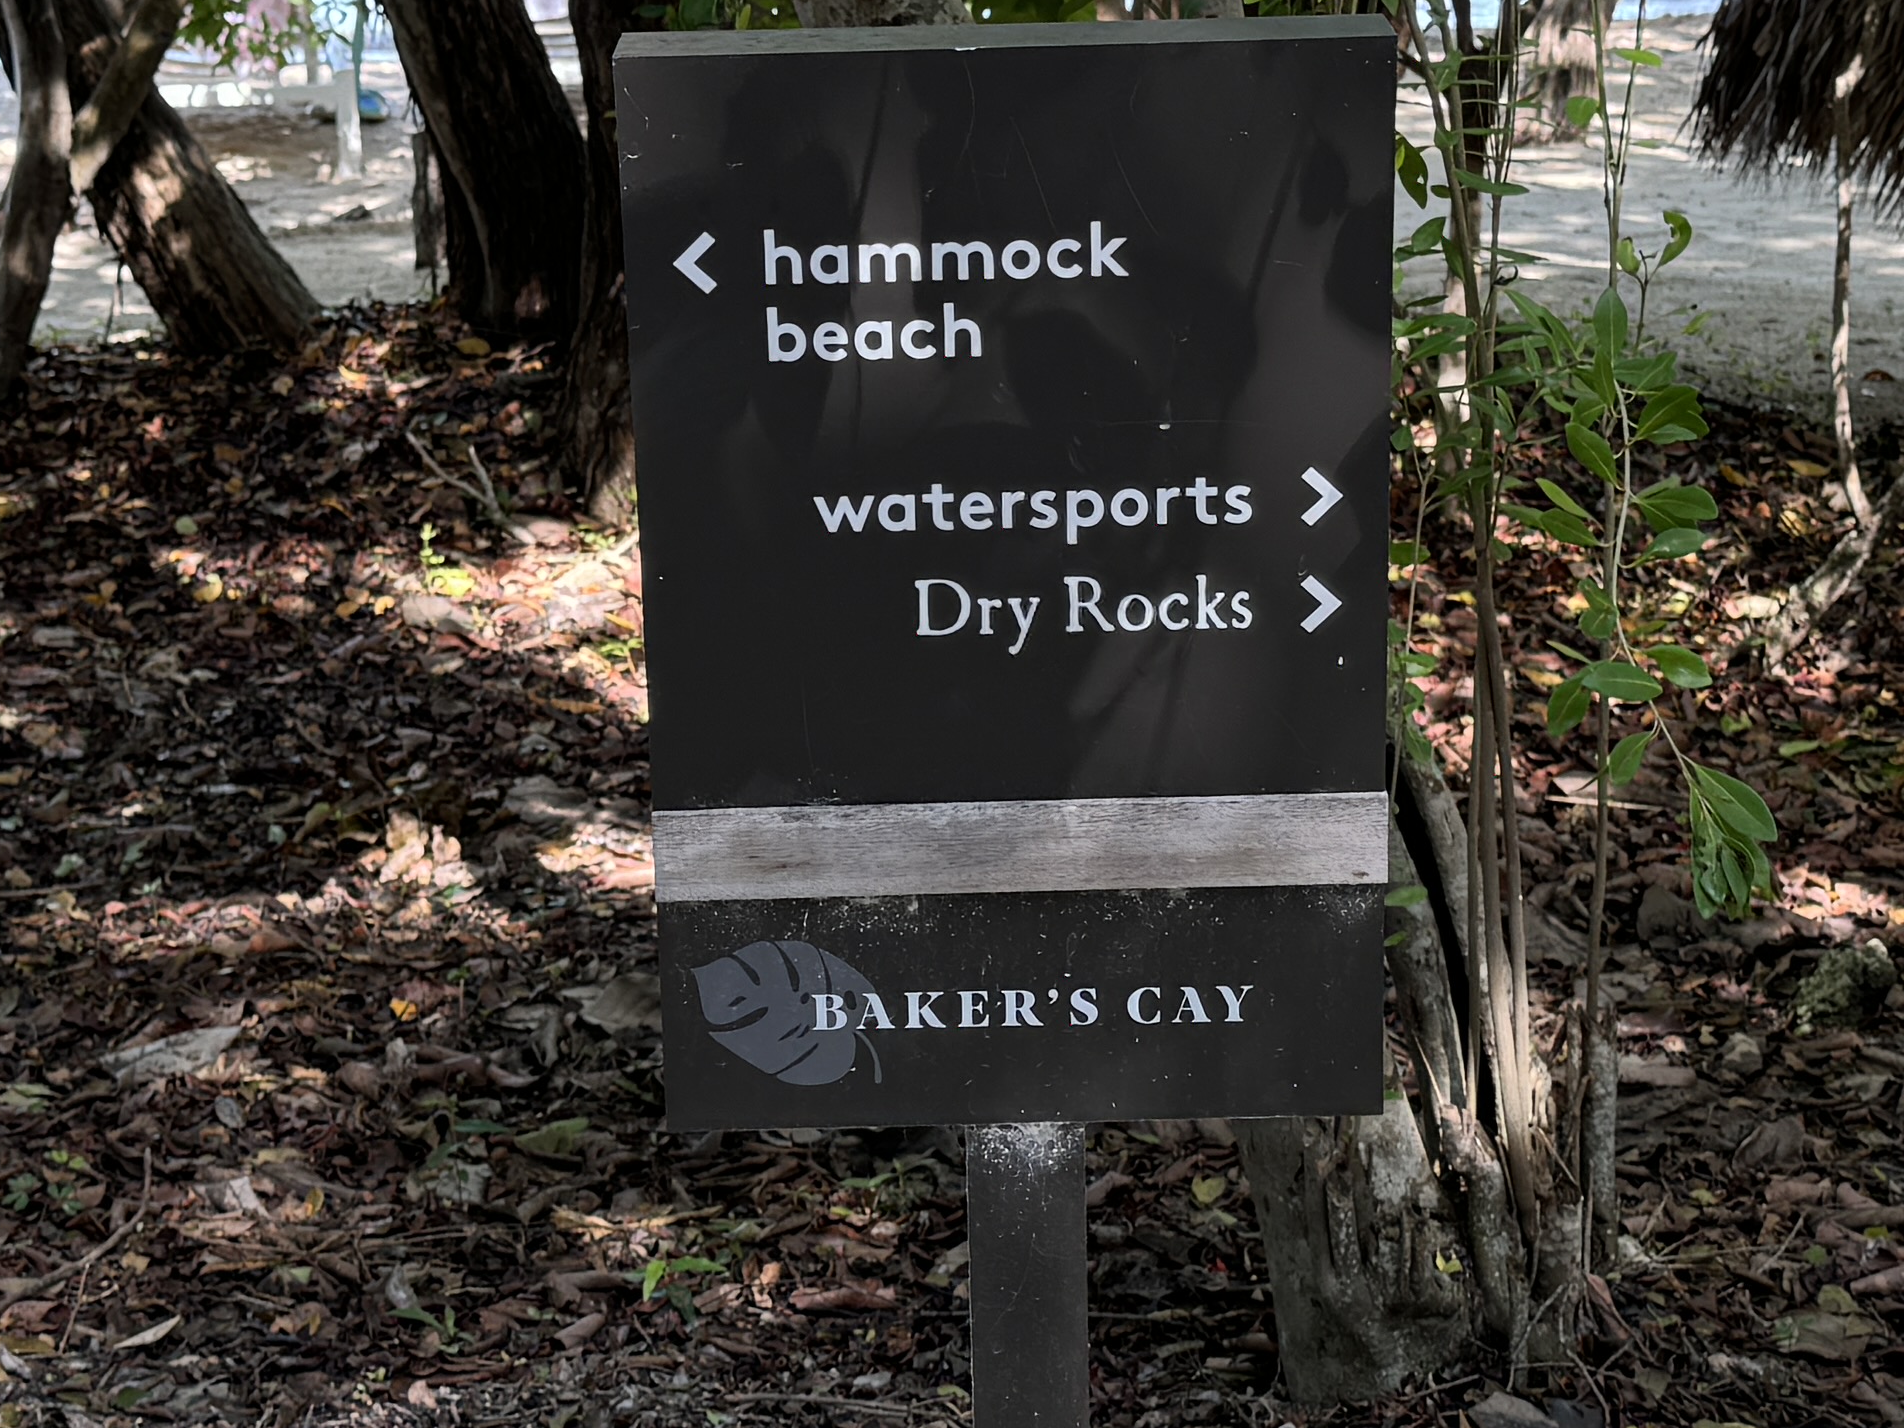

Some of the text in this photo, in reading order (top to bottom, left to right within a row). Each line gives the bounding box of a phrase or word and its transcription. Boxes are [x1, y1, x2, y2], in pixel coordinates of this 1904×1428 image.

[763, 220, 1129, 285] hammock
[766, 302, 982, 362] beach
[813, 477, 1253, 545] watersports
[914, 574, 1253, 655] Dry Rocks
[811, 985, 1254, 1031] BAKER'S CAY
